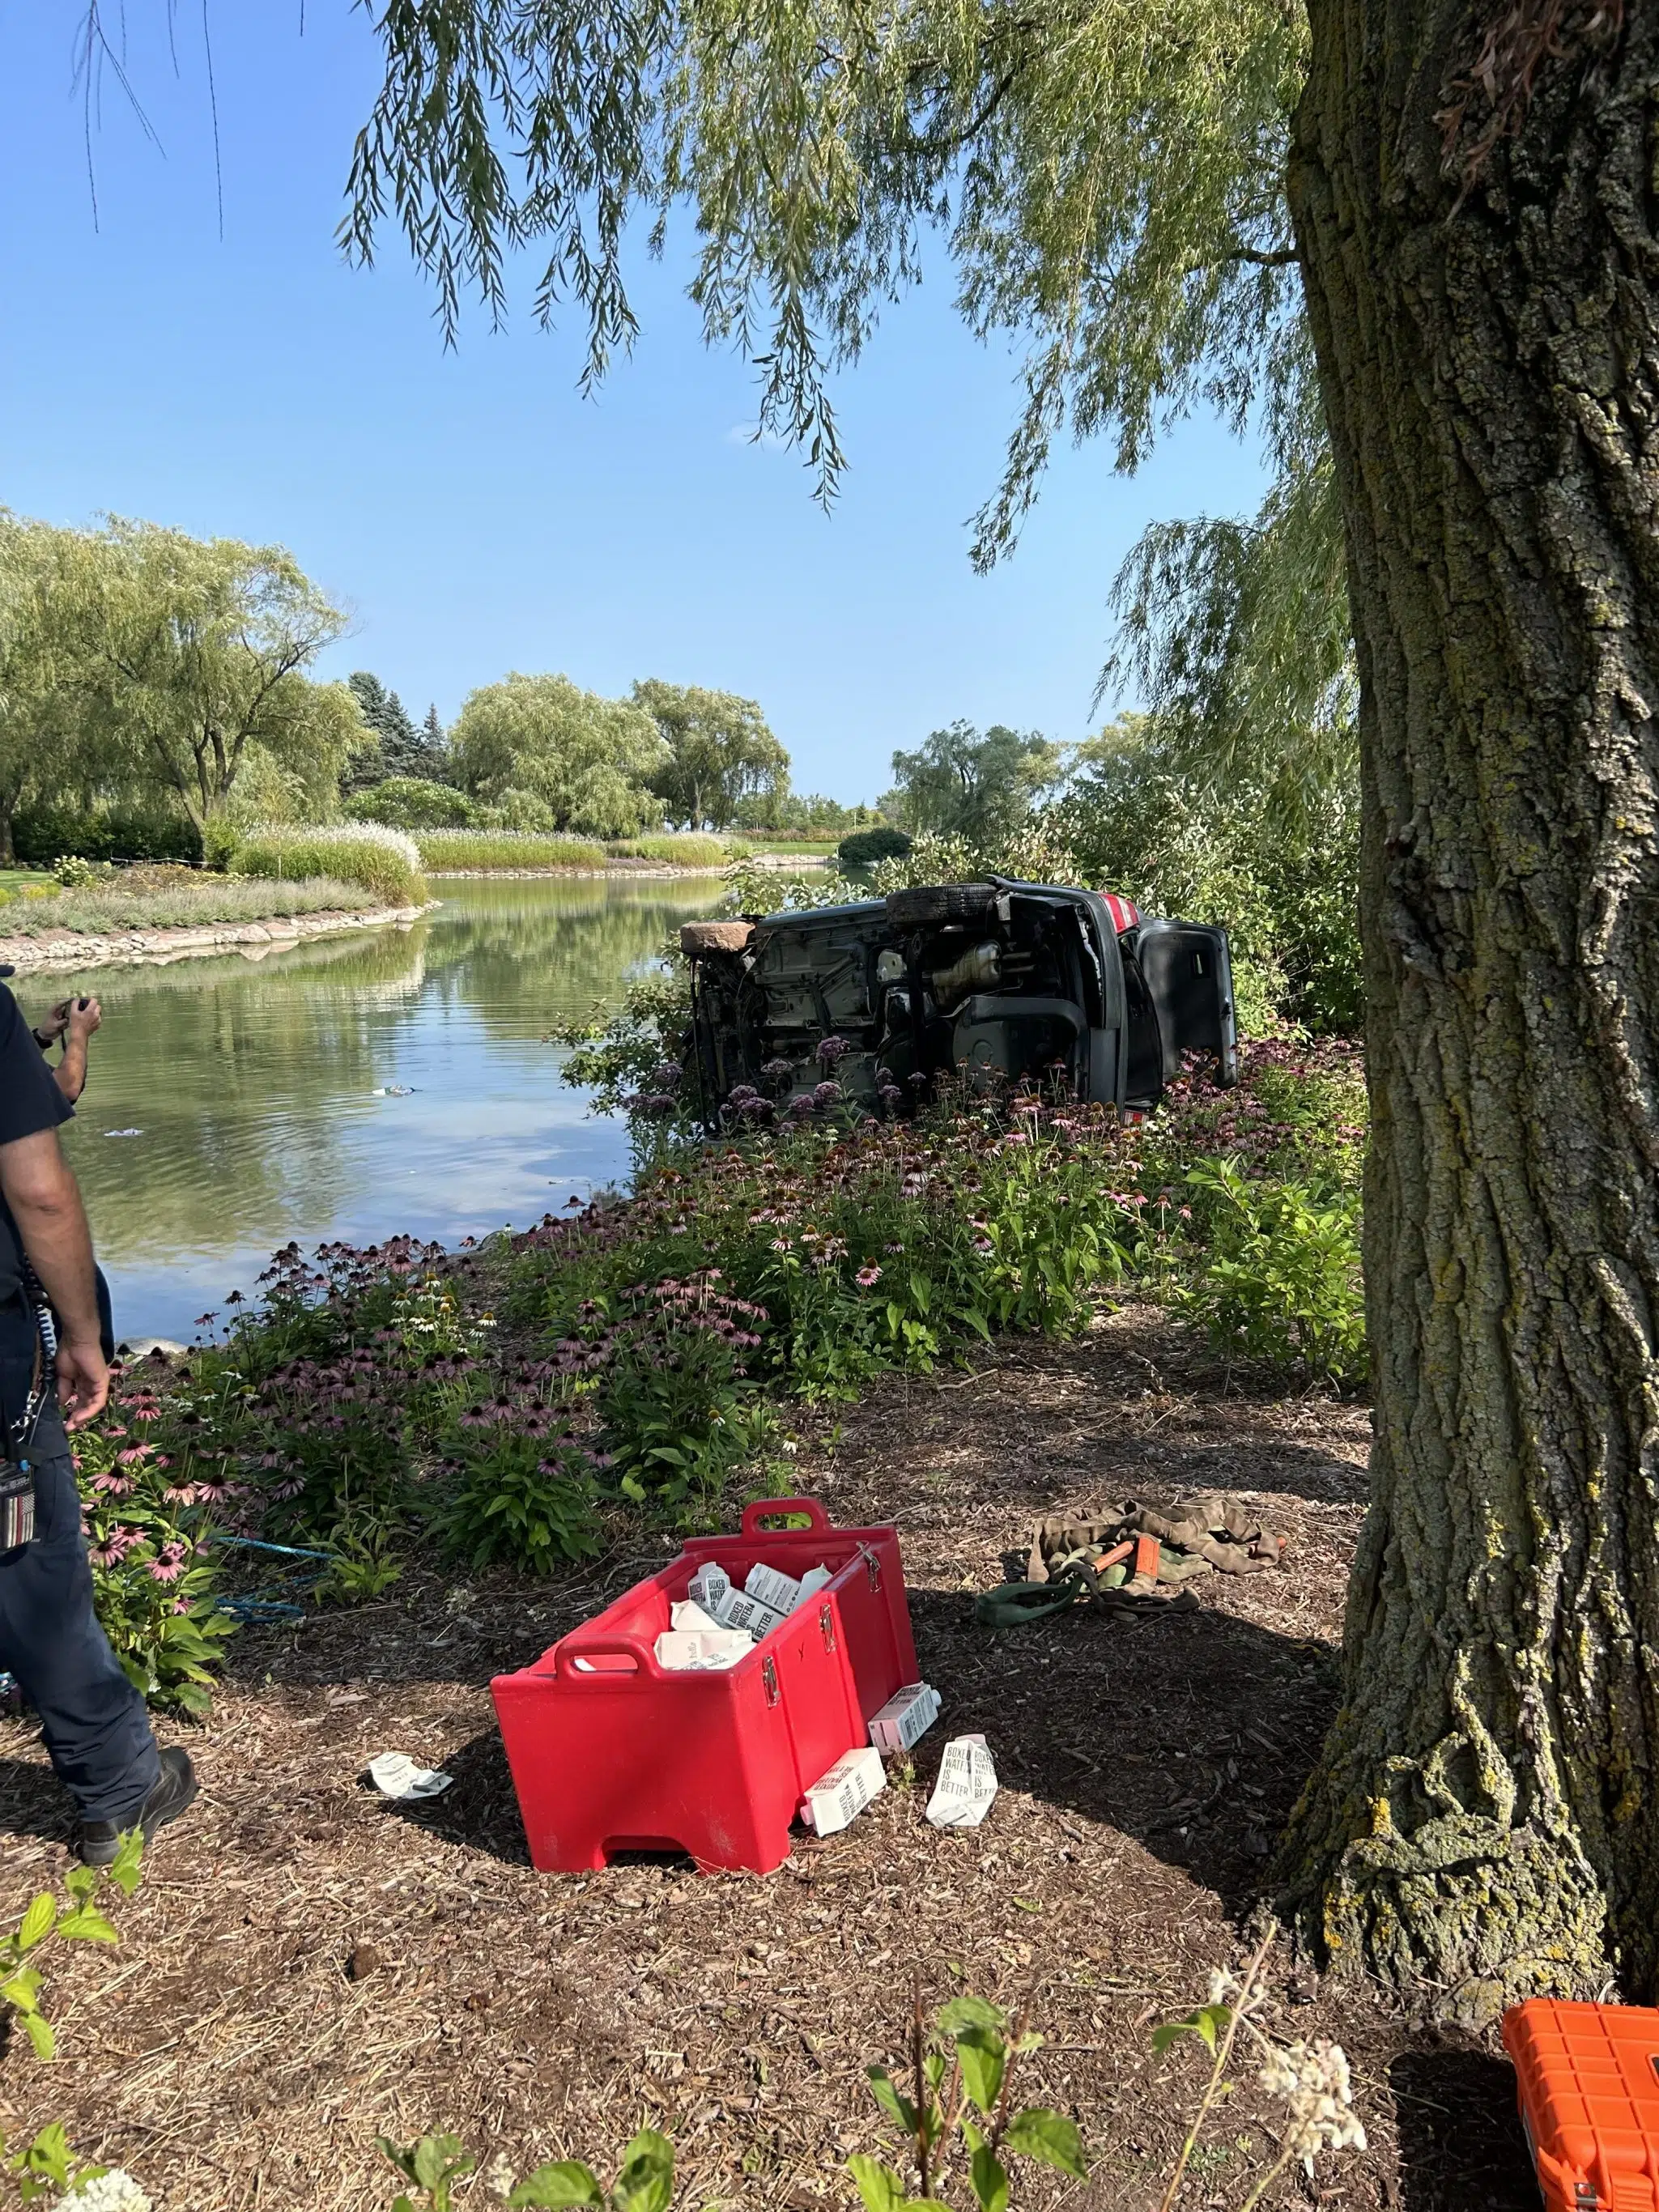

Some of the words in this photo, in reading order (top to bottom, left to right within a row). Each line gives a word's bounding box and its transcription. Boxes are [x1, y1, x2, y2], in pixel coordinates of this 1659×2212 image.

[708, 1579, 725, 1589] BOXED
[709, 1589, 725, 1601] WATE
[728, 1601, 744, 1624] BOXED
[736, 1603, 755, 1628] WATER
[942, 1768, 951, 1780] IS
[940, 1780, 969, 1797] BETTER
[974, 1776, 982, 1788] IS
[839, 1794, 851, 1822] BOXED
